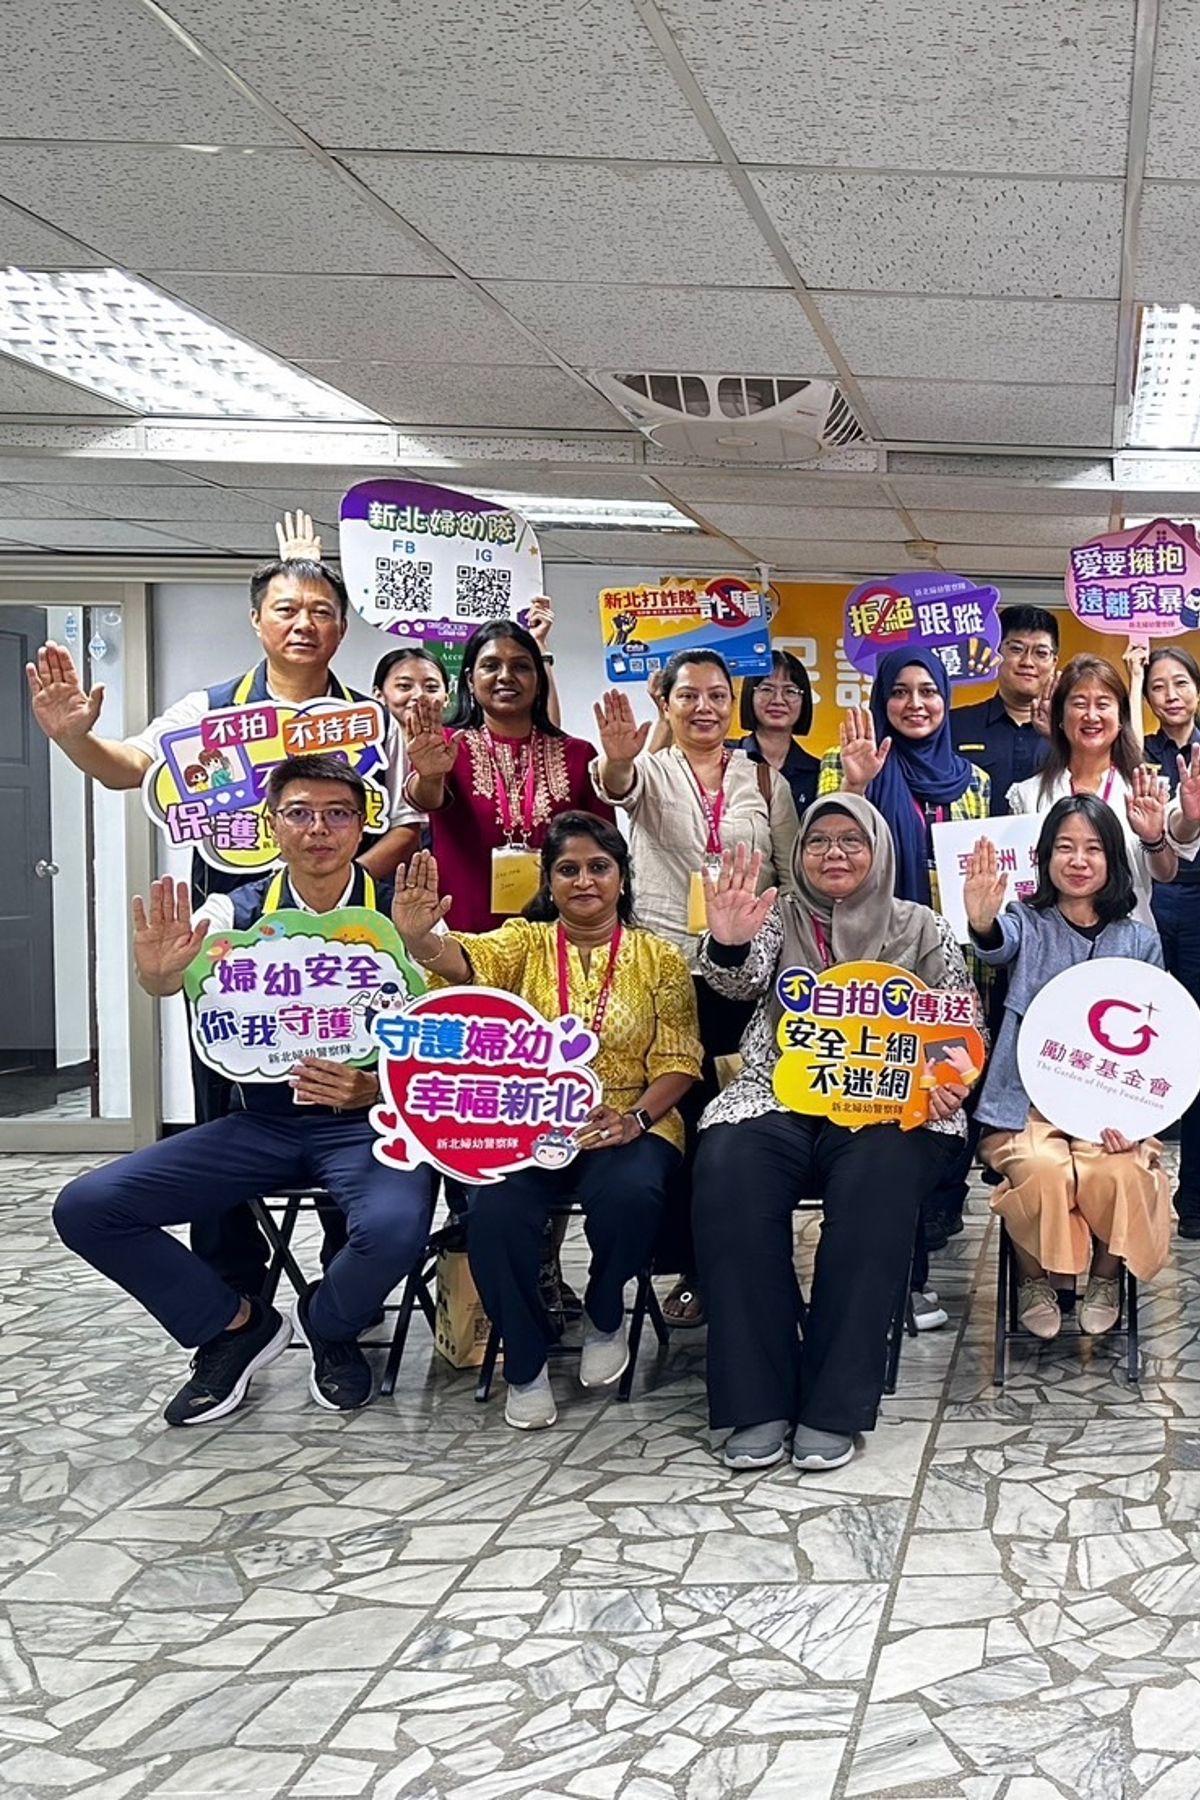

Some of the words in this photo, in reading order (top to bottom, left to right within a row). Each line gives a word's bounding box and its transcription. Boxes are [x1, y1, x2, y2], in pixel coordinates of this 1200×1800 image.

[369, 501, 515, 544] 新北婦幼隊
[392, 539, 415, 554] FB
[475, 548, 493, 562] IG
[1073, 545, 1184, 579] 愛要擁抱
[603, 590, 698, 610] 新北打詐隊
[699, 590, 762, 619] 詐騙
[1078, 585, 1183, 618] 遠離家暴
[206, 712, 268, 744] 不拍
[286, 713, 373, 748] 不持有
[218, 953, 382, 996] 婦幼安全
[200, 1004, 353, 1046] 你我守護
[375, 1016, 553, 1064] 守護婦幼
[785, 1018, 918, 1064] 安全上網
[806, 1063, 911, 1099] 不迷網
[1039, 1039, 1172, 1098] 勵馨基金會
[410, 1076, 588, 1123] 幸福新北
